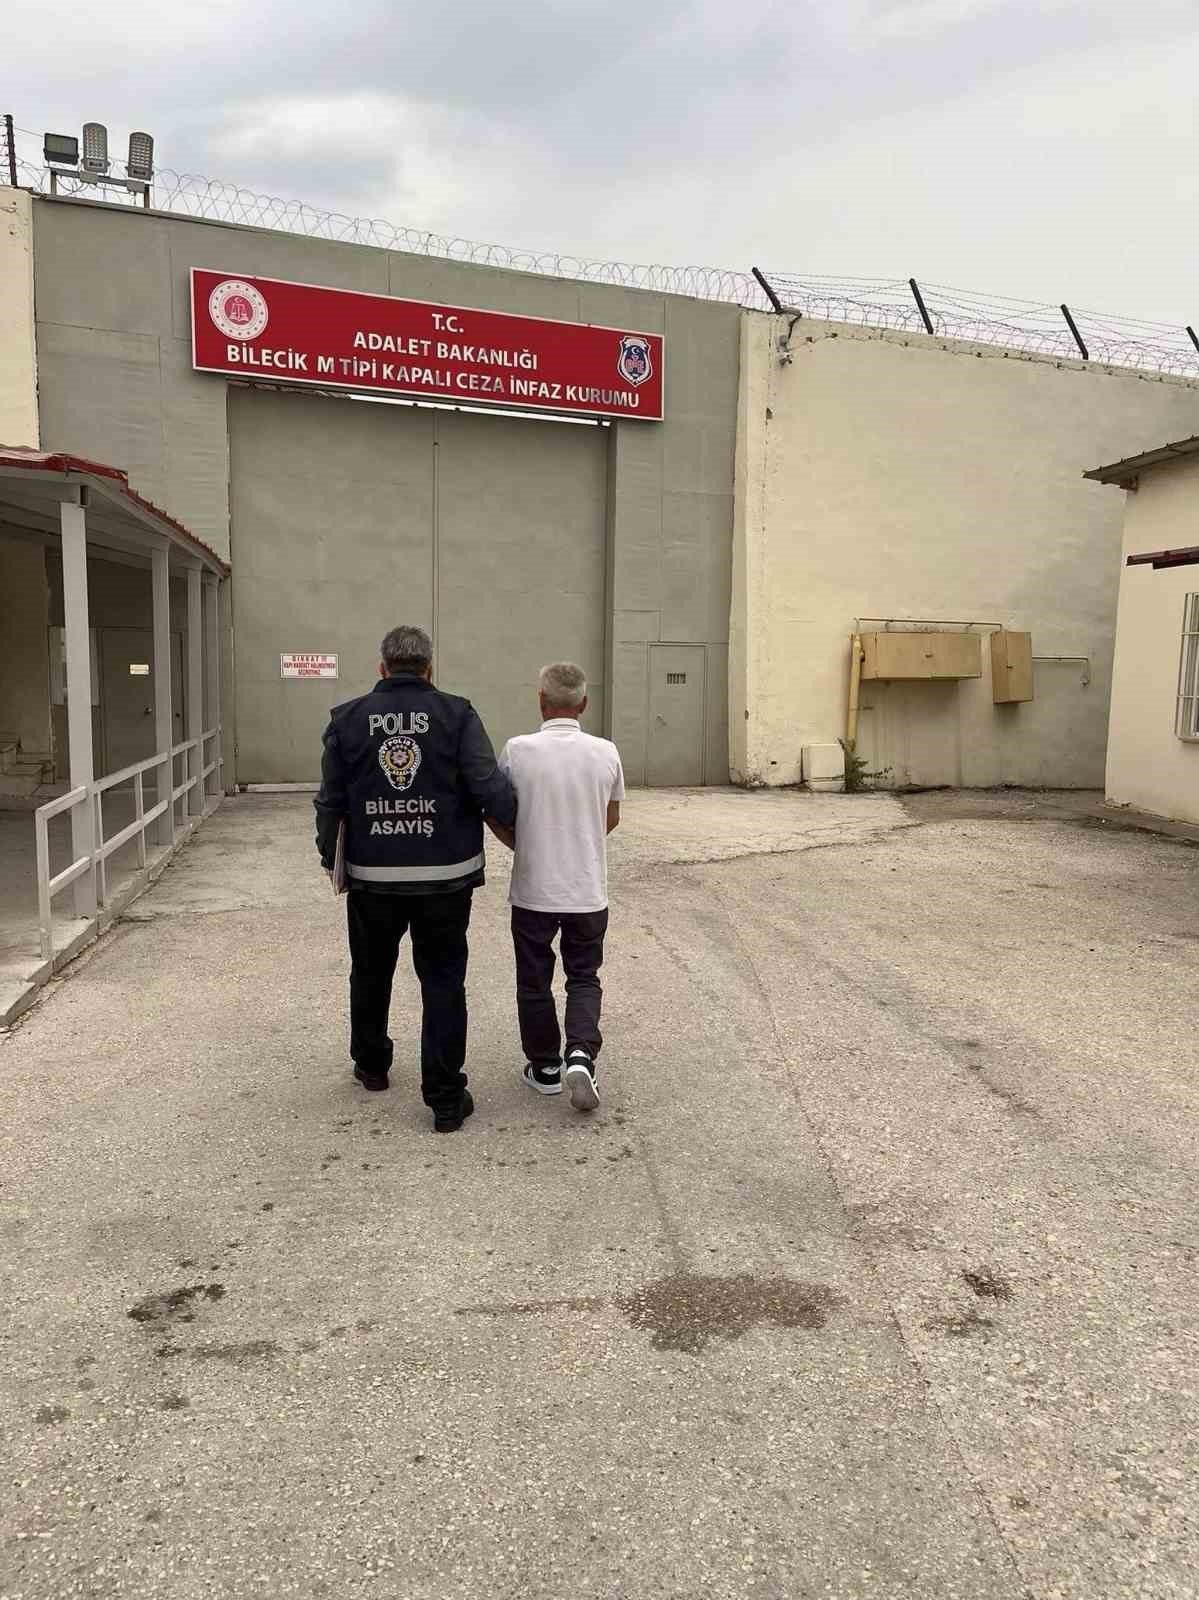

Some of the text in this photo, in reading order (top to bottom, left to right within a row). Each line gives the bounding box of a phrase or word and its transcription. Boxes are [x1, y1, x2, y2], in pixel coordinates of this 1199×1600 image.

[432, 313, 464, 333] T.C.
[353, 331, 537, 370] ADALET BAKANLIĞI
[227, 342, 639, 407] BİLECİK M TİPİ KAPALI CEZA İNFAZ KURUMU
[365, 796, 437, 815] BİLECİK
[370, 816, 434, 837] ASAYİŞ
